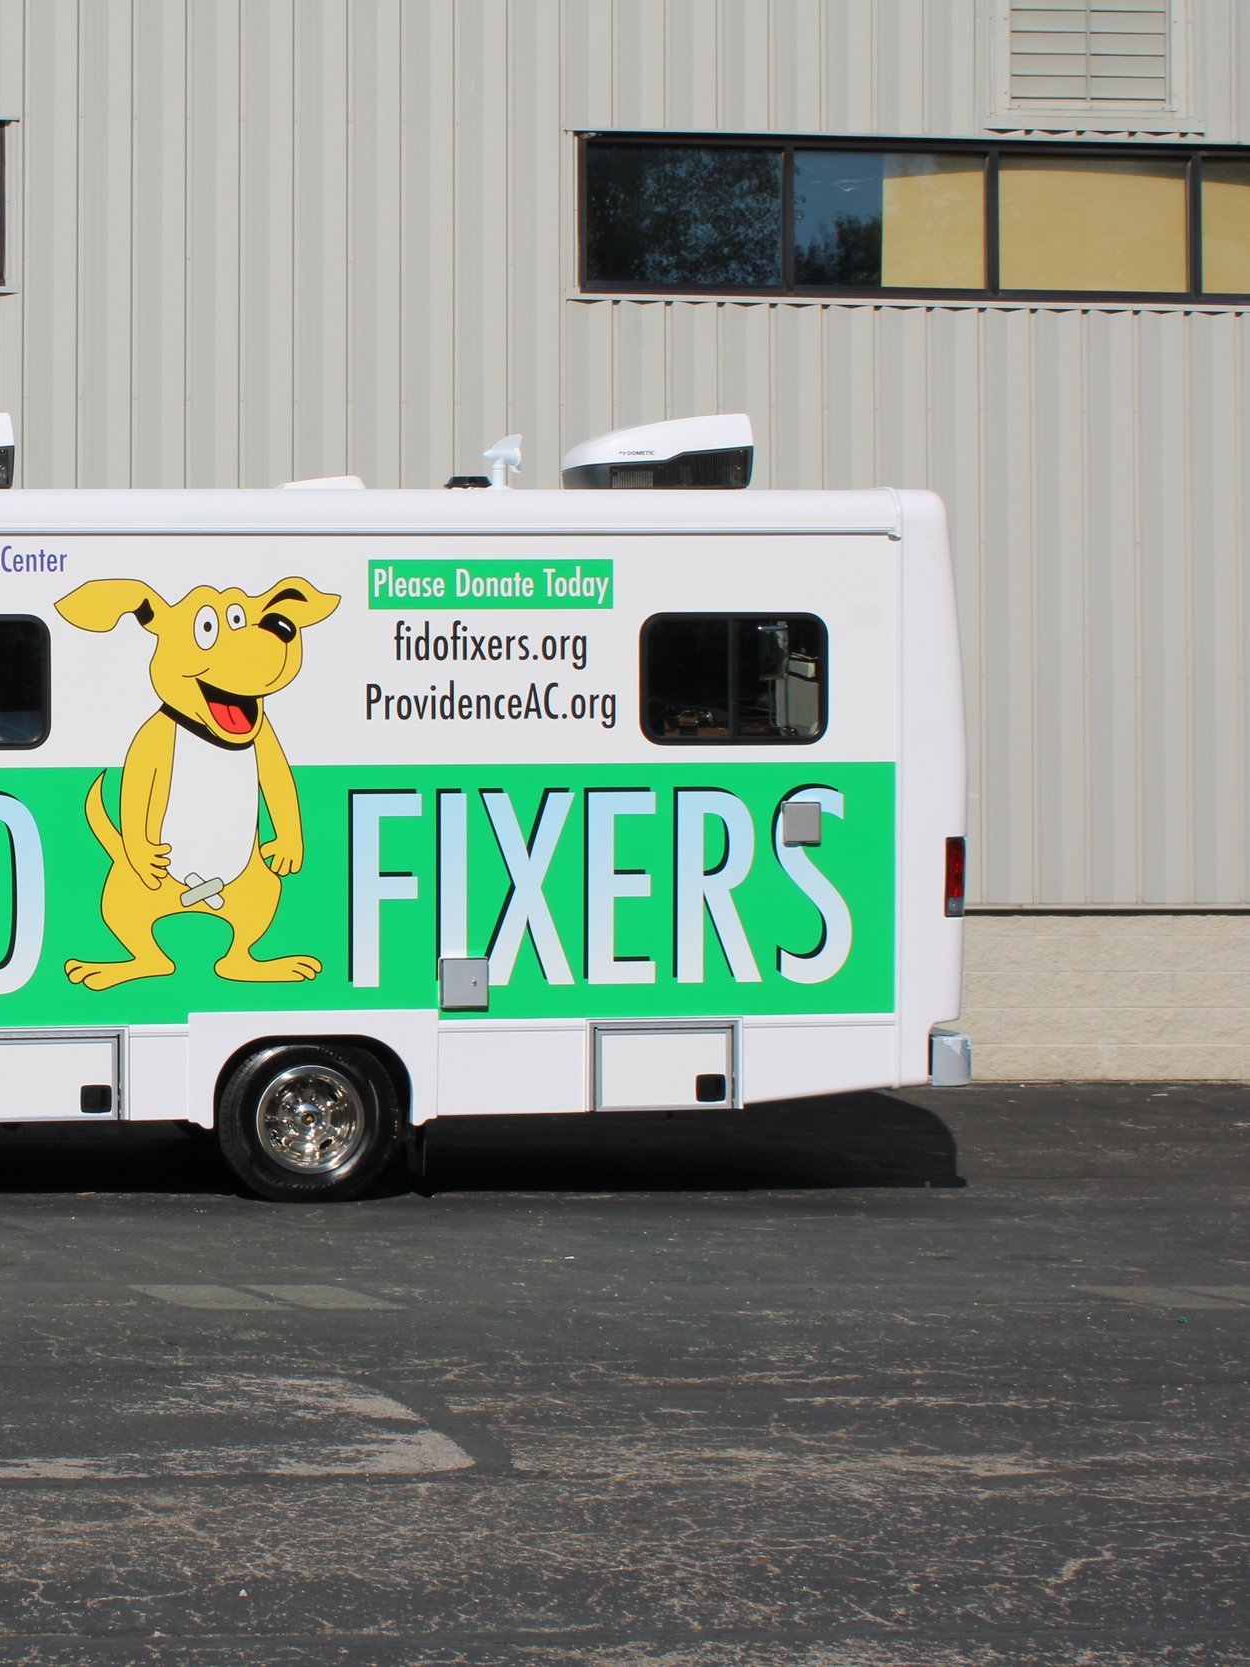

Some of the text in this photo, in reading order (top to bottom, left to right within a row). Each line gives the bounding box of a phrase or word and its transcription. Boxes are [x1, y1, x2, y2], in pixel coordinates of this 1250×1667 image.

[0, 545, 68, 573] Center
[373, 565, 610, 605] Please Donate Today
[393, 619, 588, 671] fidofixers.org
[365, 679, 617, 729] ProvidenceAC.org
[348, 783, 852, 988] FIXERS
